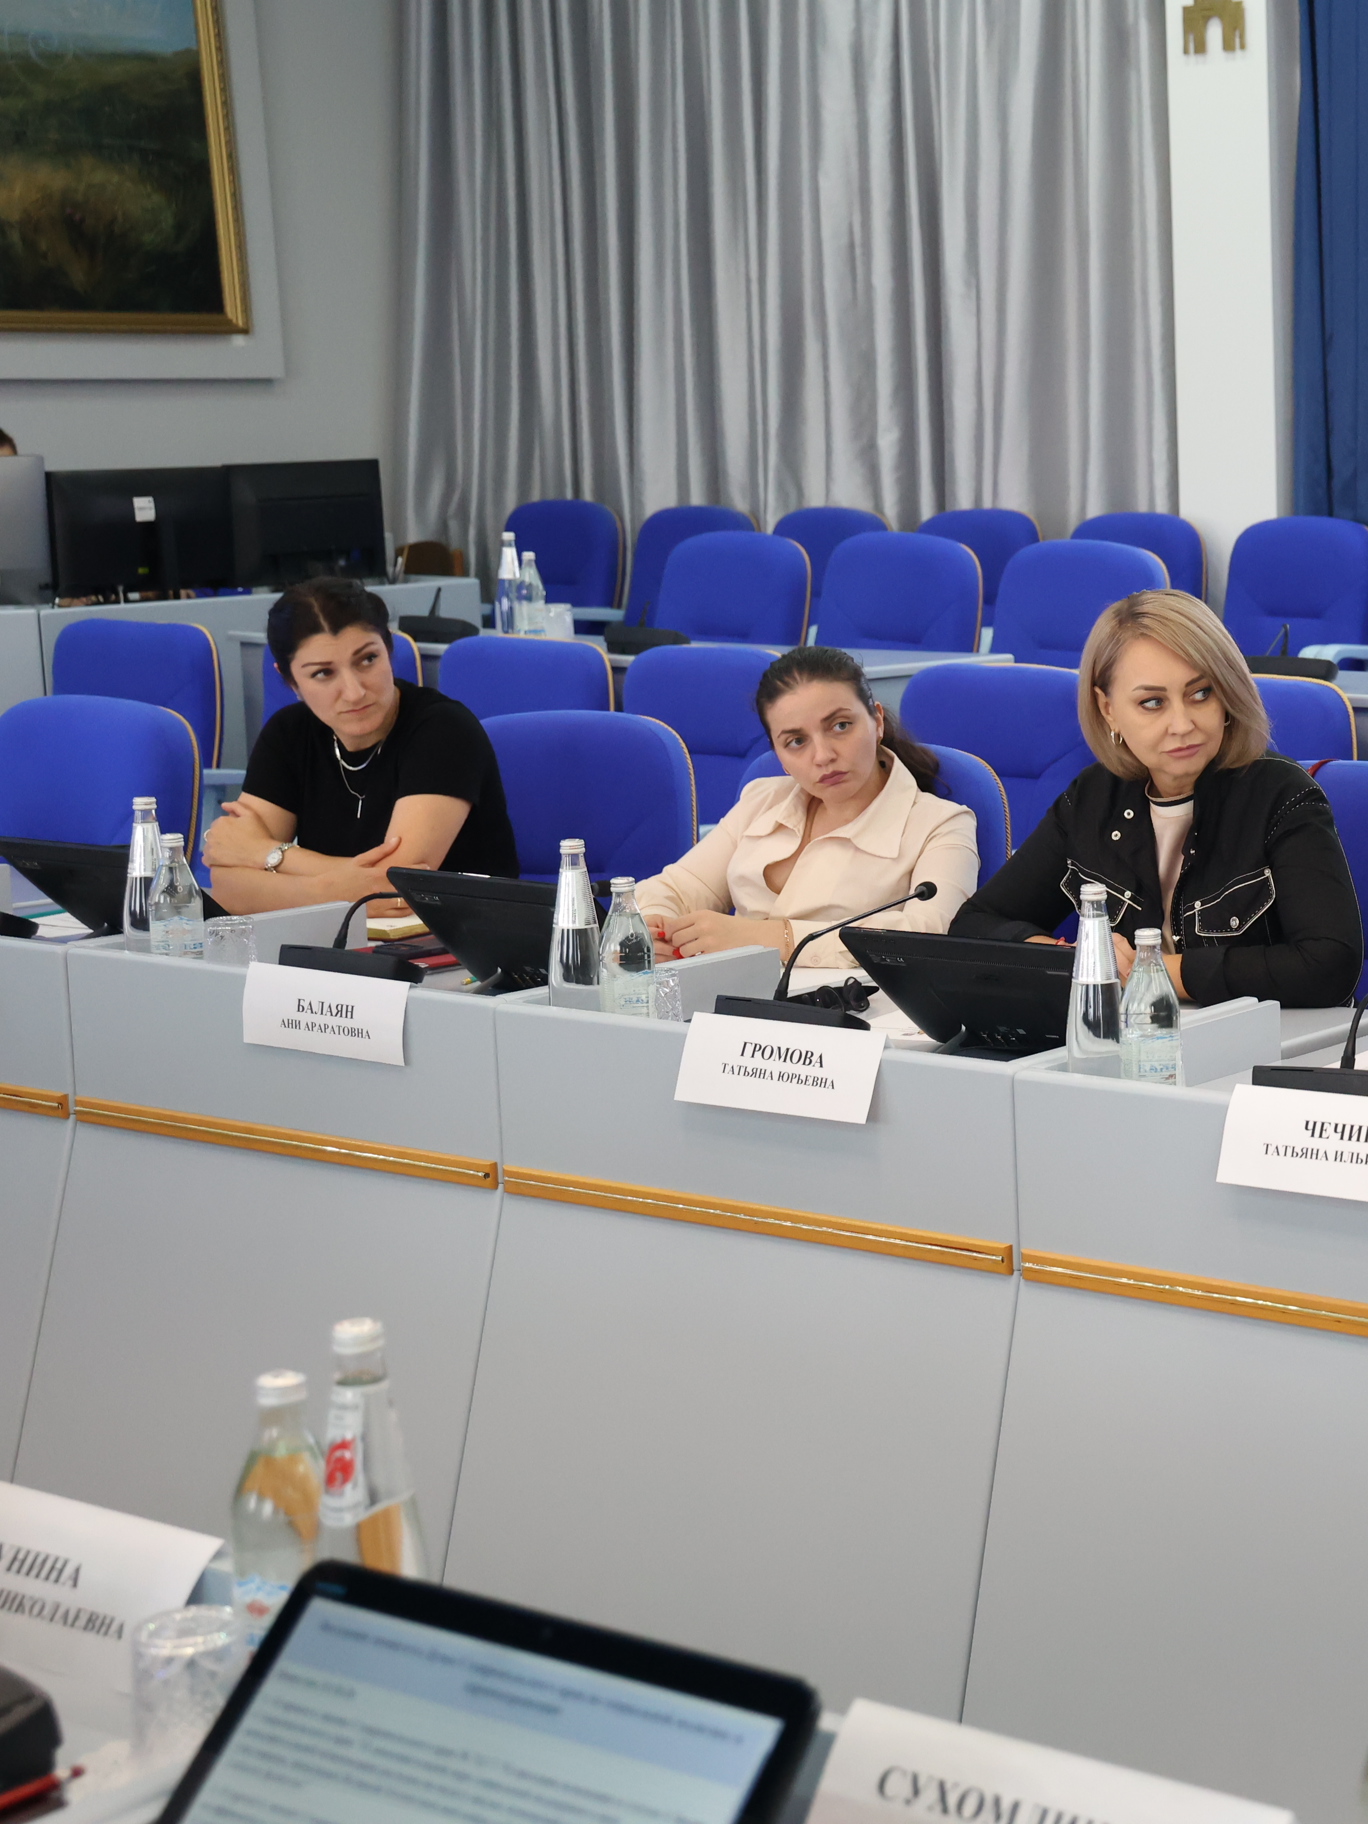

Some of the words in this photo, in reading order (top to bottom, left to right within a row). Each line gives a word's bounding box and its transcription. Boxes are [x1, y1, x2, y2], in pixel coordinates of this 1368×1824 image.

[296, 998, 355, 1019] БАЛАЯН
[280, 1018, 301, 1031] АНИ
[304, 1021, 371, 1040] АРАРАТОВНА
[740, 1041, 824, 1069] ГРОМОВА
[721, 1062, 774, 1081] ТАТЬЯНА
[777, 1070, 836, 1090] ЮРЬЕВНА
[1263, 1142, 1329, 1162] ТАТЬЯНА
[0, 1542, 82, 1589] НИНА
